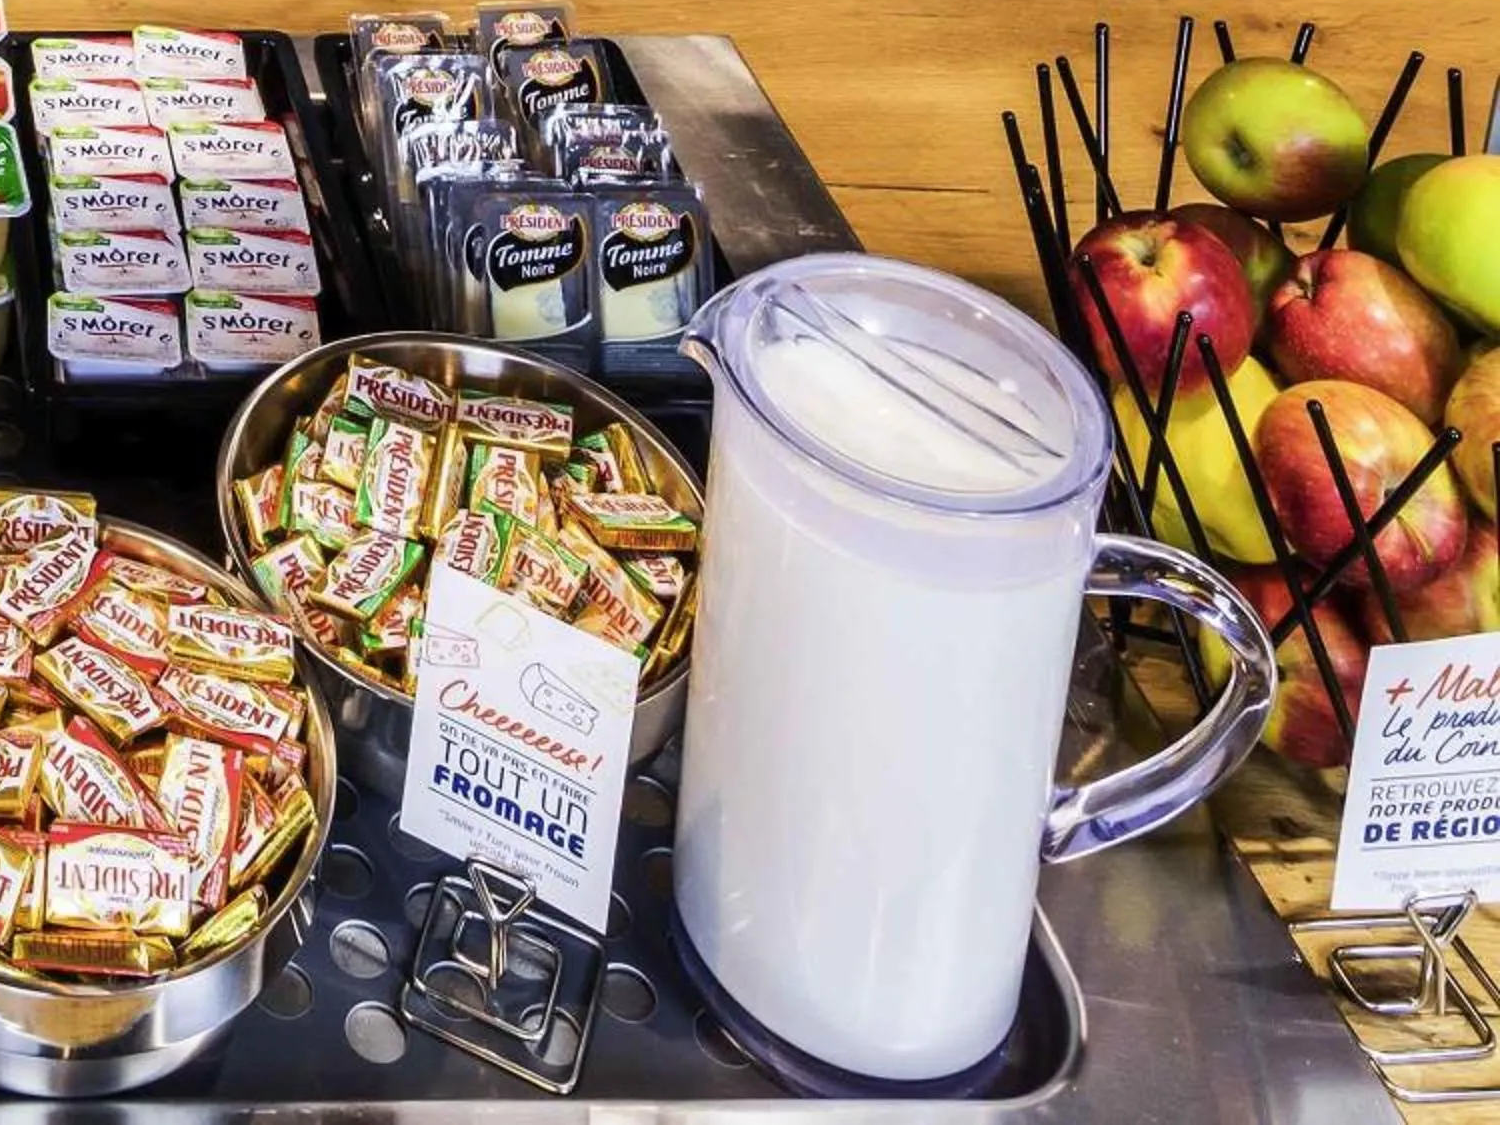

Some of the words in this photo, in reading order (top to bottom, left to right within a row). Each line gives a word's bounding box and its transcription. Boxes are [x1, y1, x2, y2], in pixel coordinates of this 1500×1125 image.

[525, 83, 591, 114] Tomme
[496, 241, 573, 268] Tomme
[606, 238, 684, 268] Tomme
[521, 261, 556, 278] Noire
[632, 261, 667, 278] Noire
[1382, 706, 1414, 738] Le
[1384, 737, 1427, 766] du
[1435, 730, 1500, 764] Coin
[439, 735, 529, 800] TOUT
[1370, 776, 1499, 802] RETROUVEZ
[433, 764, 585, 859] FROMAGE
[1368, 800, 1435, 819] NOTRE
[1363, 821, 1402, 844] DE
